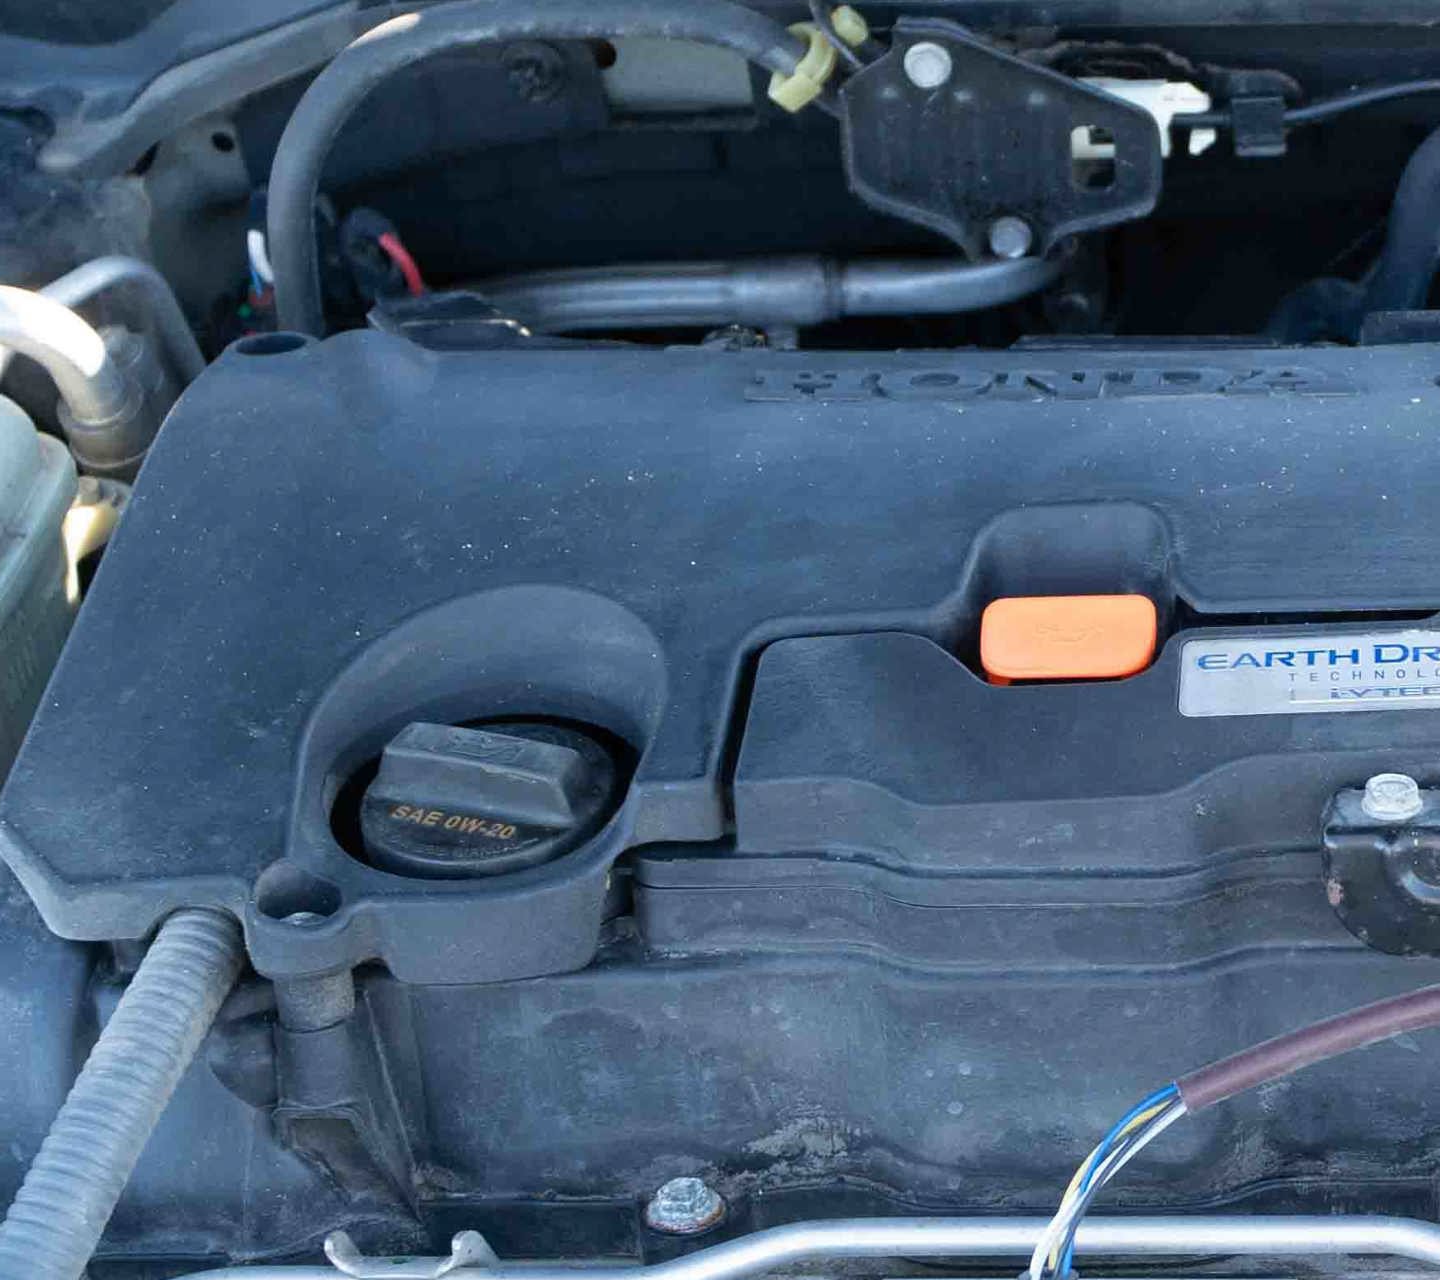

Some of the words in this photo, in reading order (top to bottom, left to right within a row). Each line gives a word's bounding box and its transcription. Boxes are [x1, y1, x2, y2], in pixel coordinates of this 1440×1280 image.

[744, 367, 1361, 402] HONDA
[1196, 648, 1360, 671] EARTH
[392, 805, 442, 826] SAE
[444, 818, 516, 840] 0W-20
